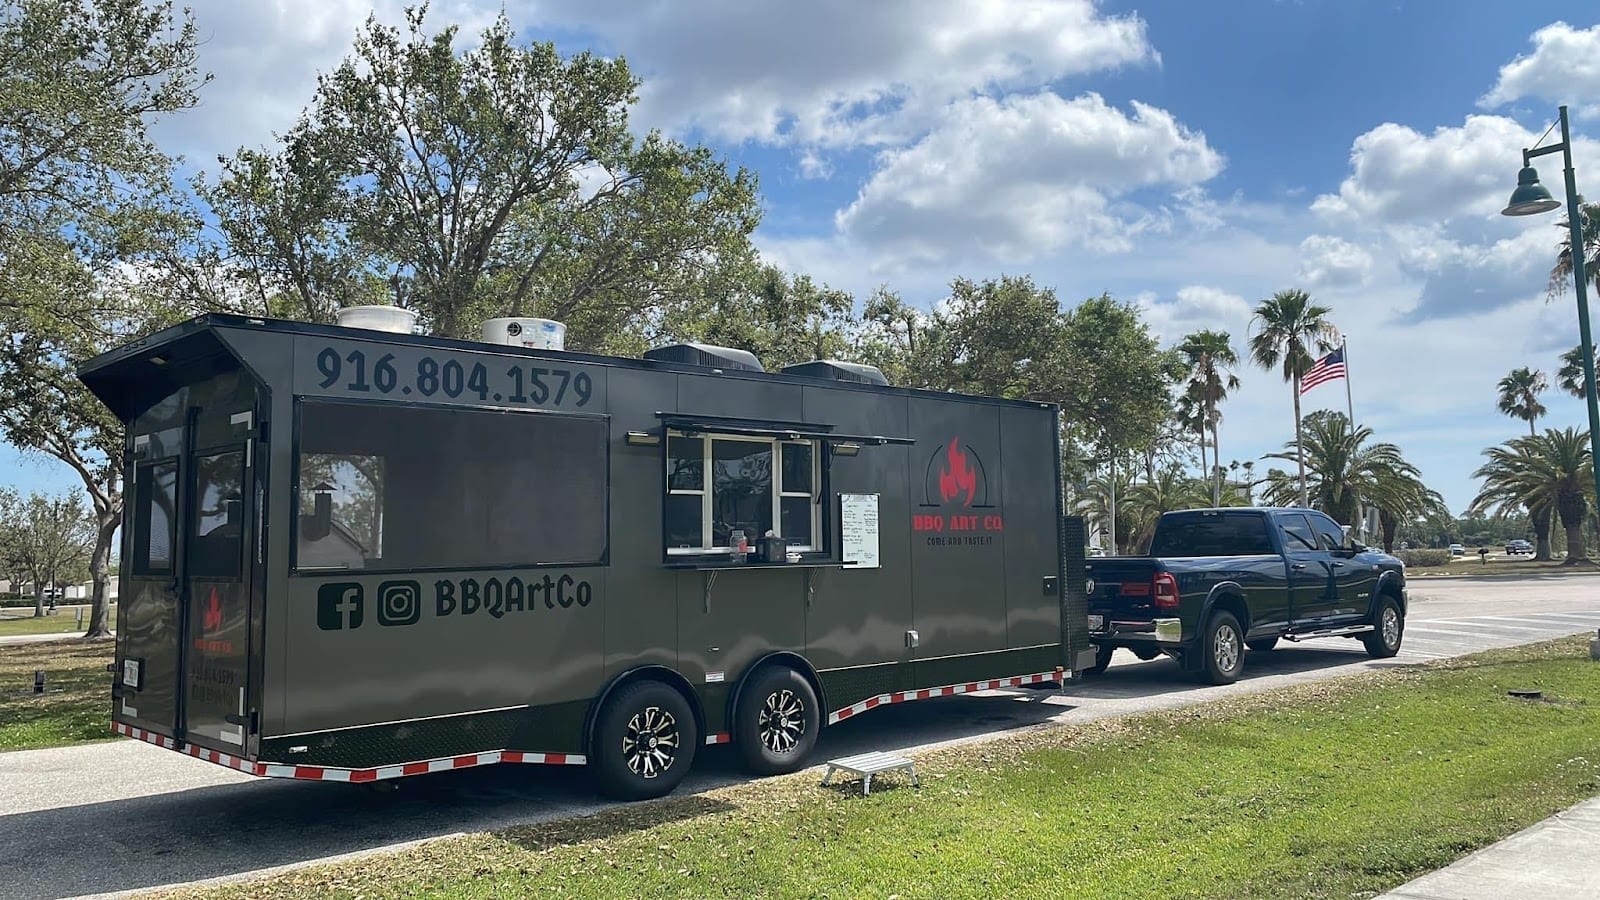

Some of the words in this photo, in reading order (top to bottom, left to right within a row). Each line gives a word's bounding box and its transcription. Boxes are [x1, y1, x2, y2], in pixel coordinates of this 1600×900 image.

[316, 346, 593, 408] 916.804.1579
[912, 514, 945, 532] BBQ
[949, 514, 979, 531] ART
[983, 514, 1004, 531] CO
[927, 536, 946, 546] COME
[964, 536, 985, 546] TASTE
[434, 574, 593, 619] BBQArtCo
